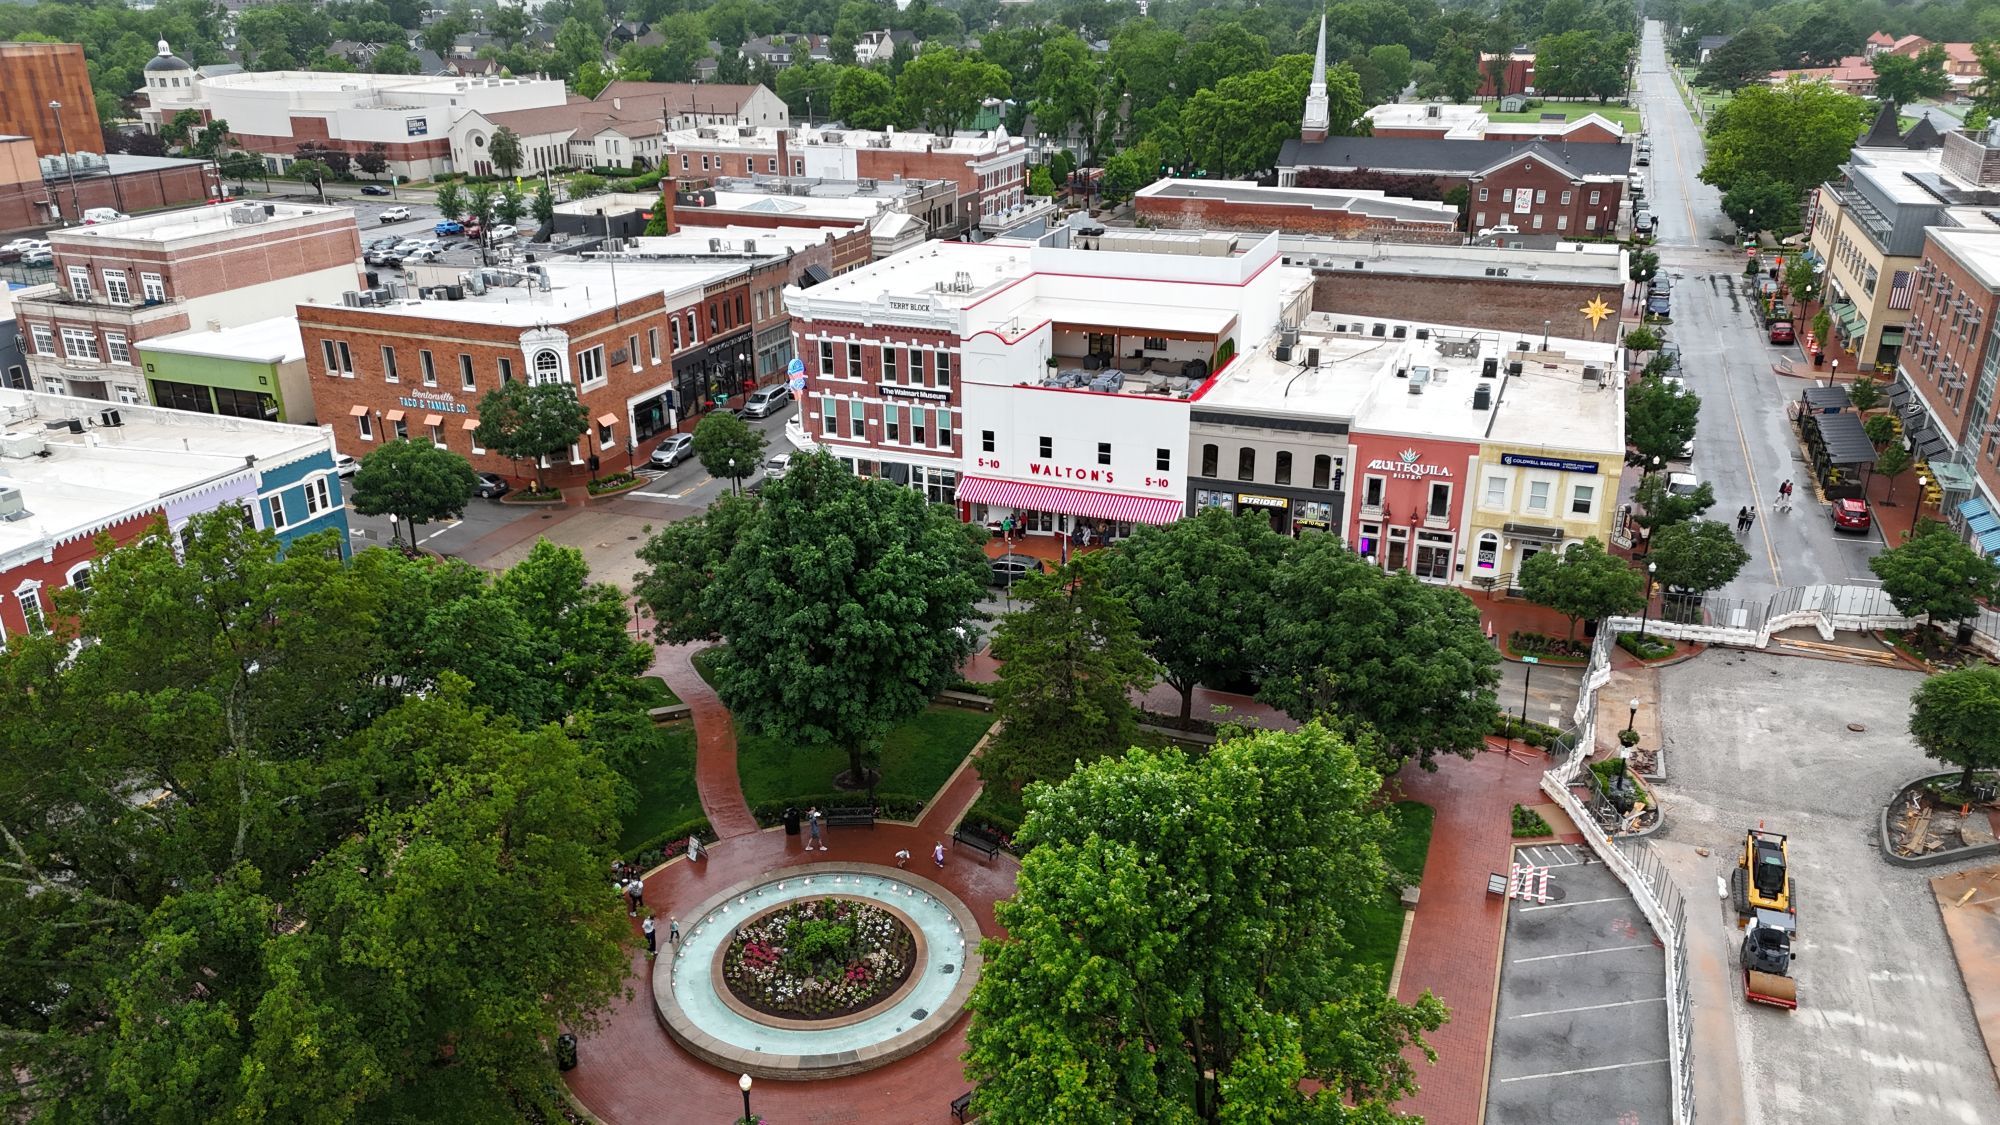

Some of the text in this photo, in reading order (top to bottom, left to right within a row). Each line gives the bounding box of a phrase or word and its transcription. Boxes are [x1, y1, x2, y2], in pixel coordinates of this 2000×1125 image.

[890, 302, 929, 311] TERRY BLOCK
[412, 388, 454, 401] Bentonville
[882, 387, 947, 400] The Walmart Museum
[399, 397, 468, 413] TACO & TAMALE CO.
[978, 458, 1000, 469] 5-10
[1030, 463, 1114, 483] WALTON'S
[1145, 477, 1169, 488] 5-10
[1241, 496, 1284, 507] STRIDER
